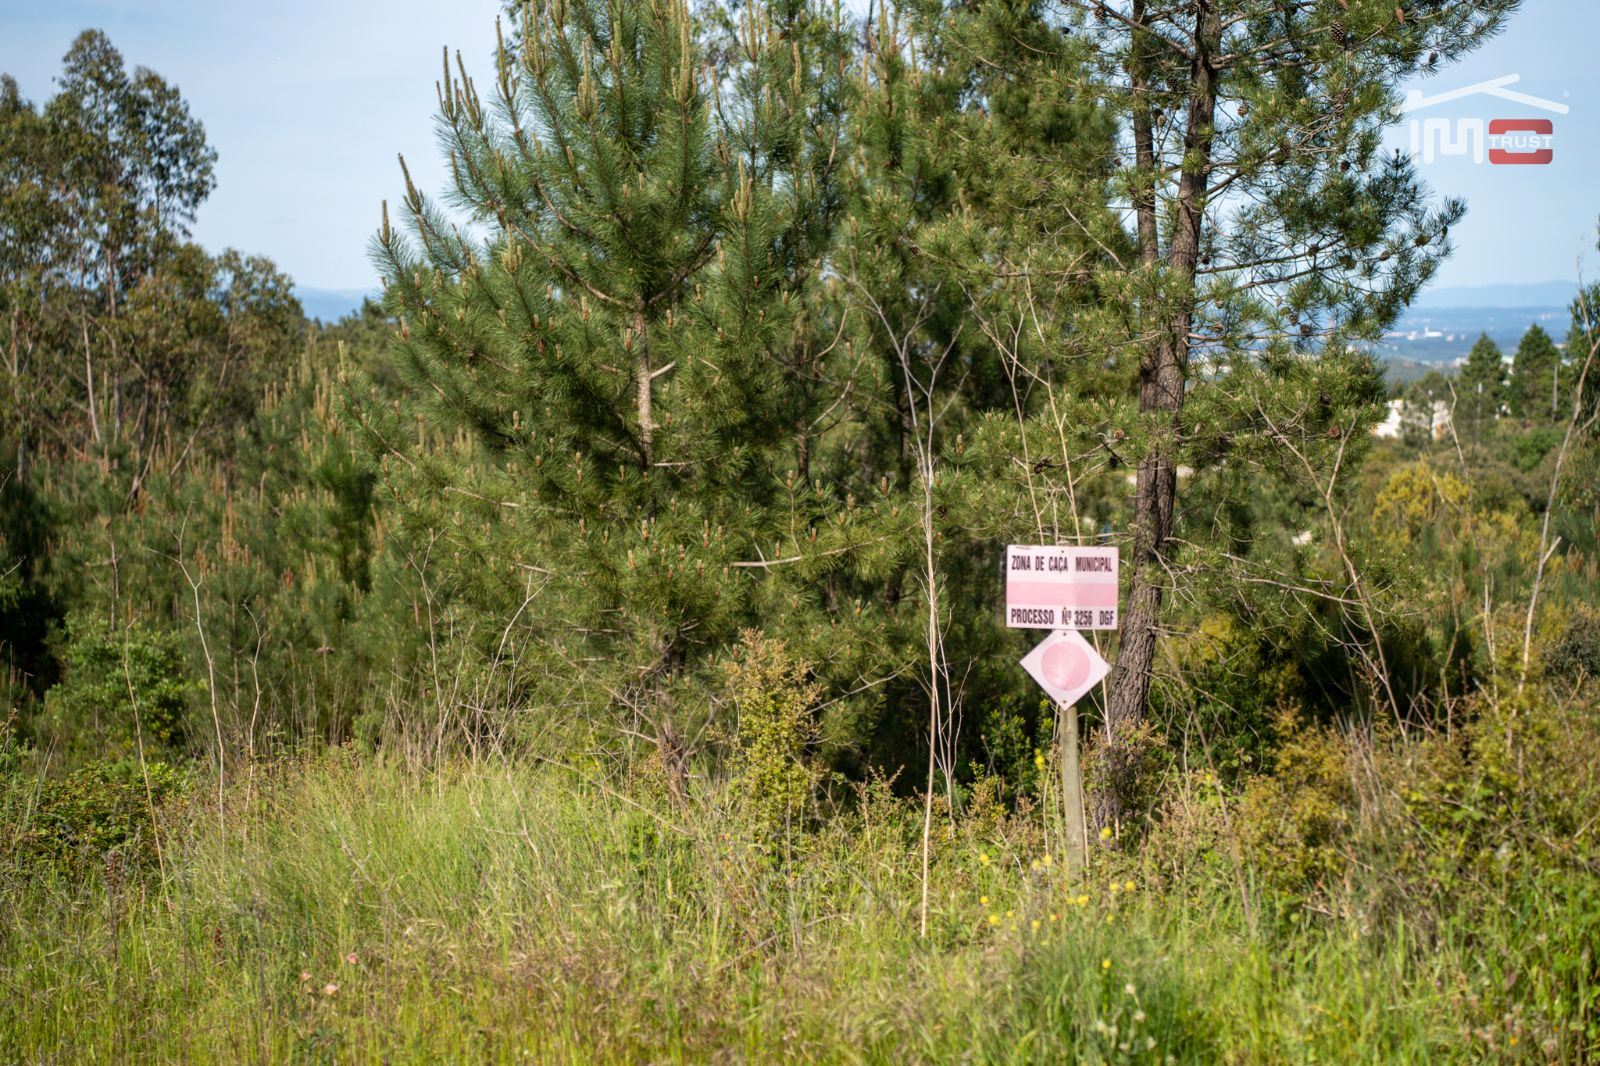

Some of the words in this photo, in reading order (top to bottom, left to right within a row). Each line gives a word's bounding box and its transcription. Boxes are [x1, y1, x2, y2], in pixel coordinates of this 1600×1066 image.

[1011, 555, 1031, 570] ZONA
[1035, 556, 1045, 571] DE
[1048, 557, 1068, 573] CAÇA
[1075, 557, 1112, 572] MUNICIPAL
[1011, 608, 1054, 624] PROCESSO
[1099, 611, 1114, 625] DGF
